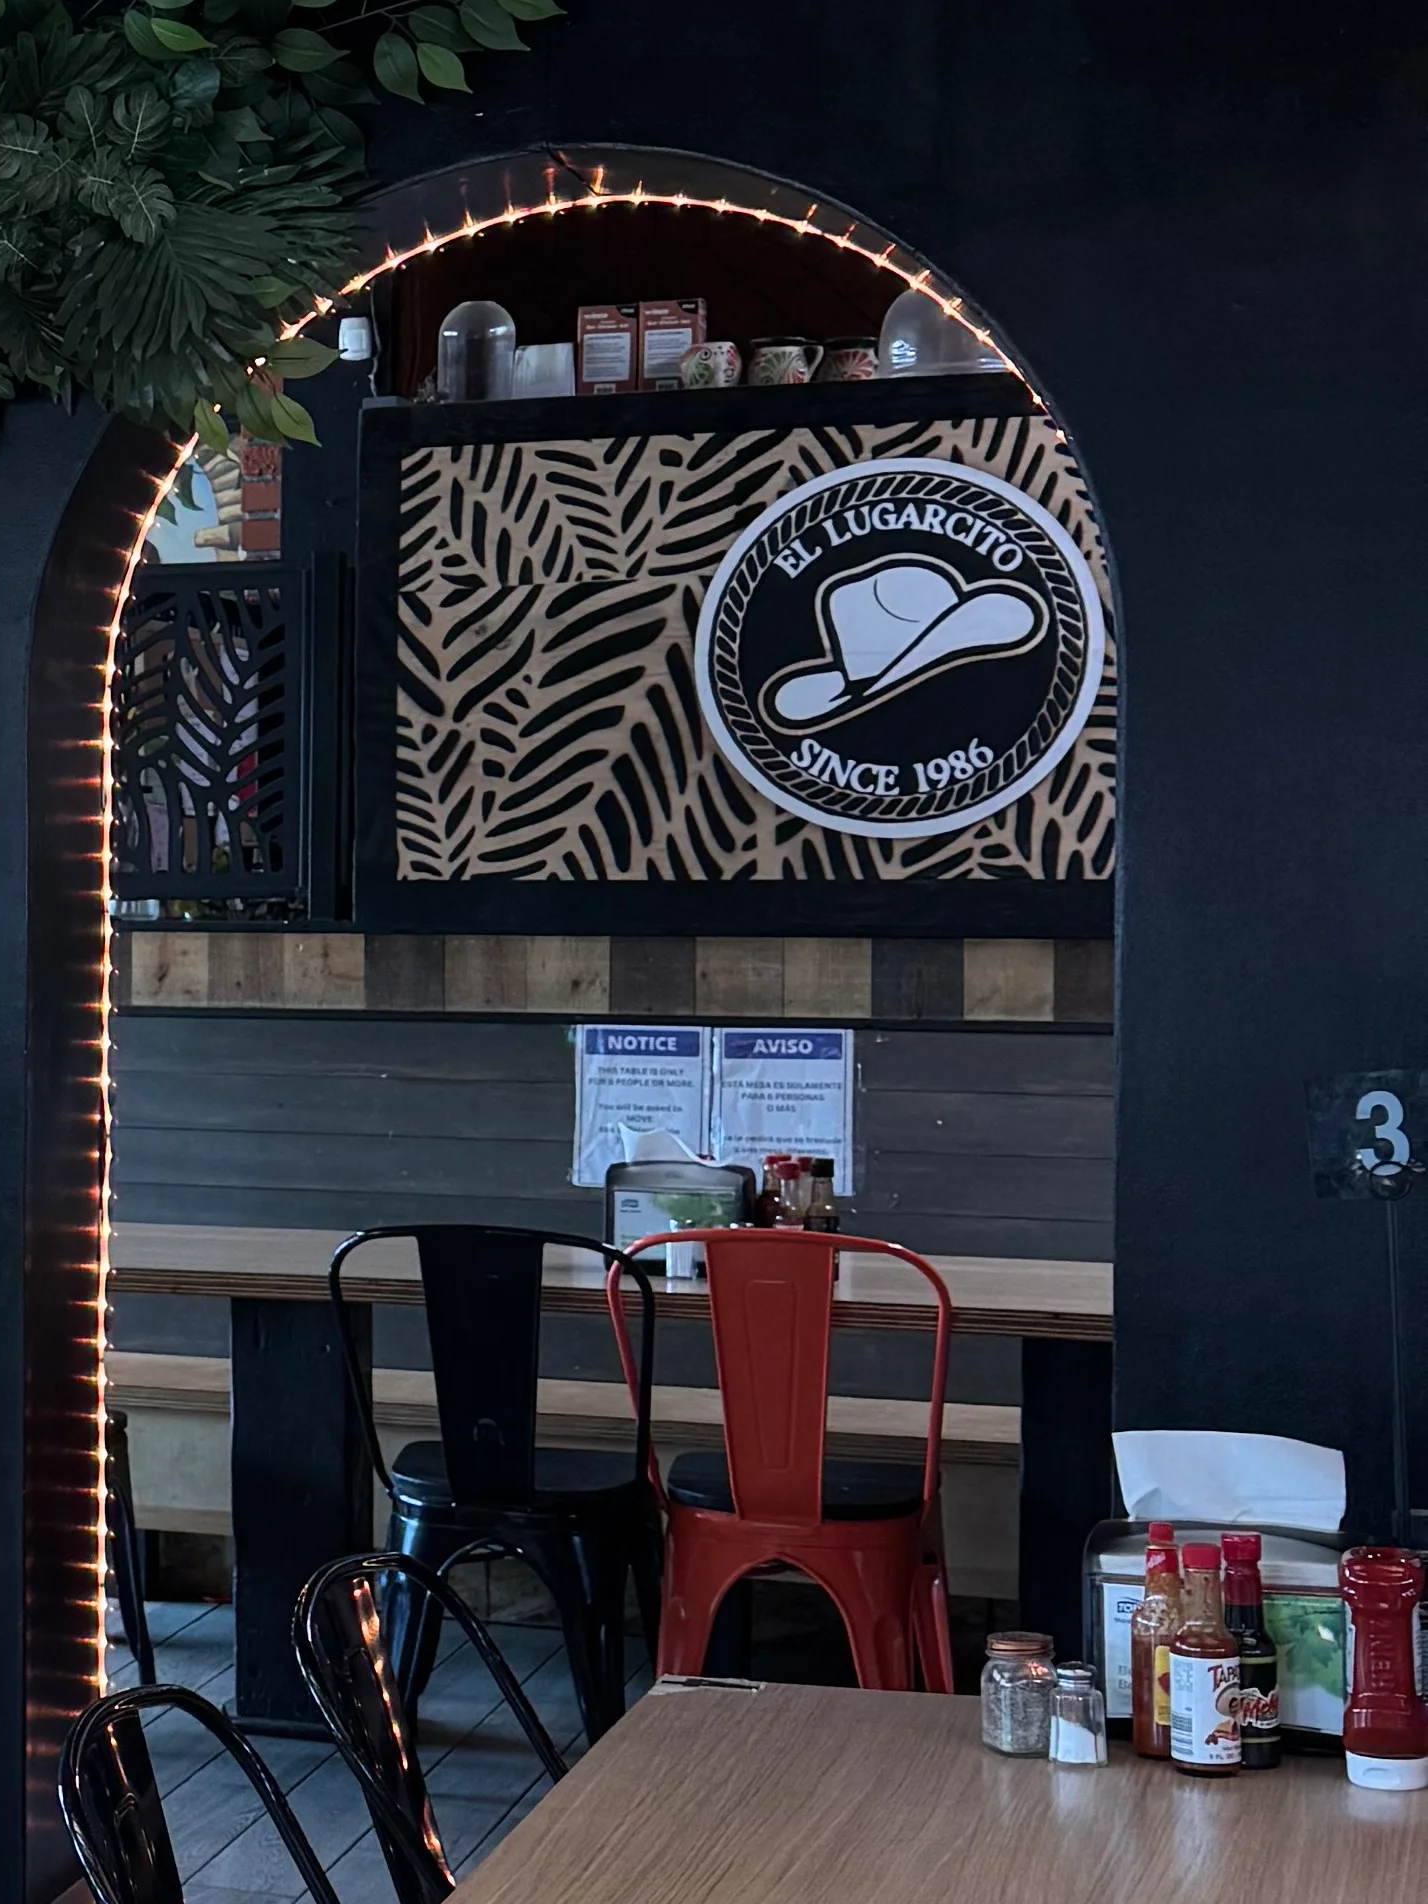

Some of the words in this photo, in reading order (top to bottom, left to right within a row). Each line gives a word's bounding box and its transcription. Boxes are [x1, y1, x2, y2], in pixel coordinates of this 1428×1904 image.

[773, 538, 822, 578] EL
[822, 502, 1024, 572] LUGARCITO
[790, 738, 899, 796] SINCE
[912, 738, 994, 794] 1986
[608, 1036, 677, 1052] NOTICE
[752, 1039, 814, 1054] AVISO
[598, 1067, 619, 1075] THIS
[621, 1067, 648, 1075] TABLE
[649, 1067, 658, 1075] IS
[660, 1067, 684, 1076] ONLY
[588, 1078, 606, 1086] FOR
[616, 1078, 650, 1087] PEOPLE
[651, 1079, 665, 1087] OR
[746, 1081, 771, 1089] MESA
[775, 1093, 825, 1101] PERSONAS
[626, 1115, 652, 1123] MOVE
[1356, 1090, 1410, 1176] 3
